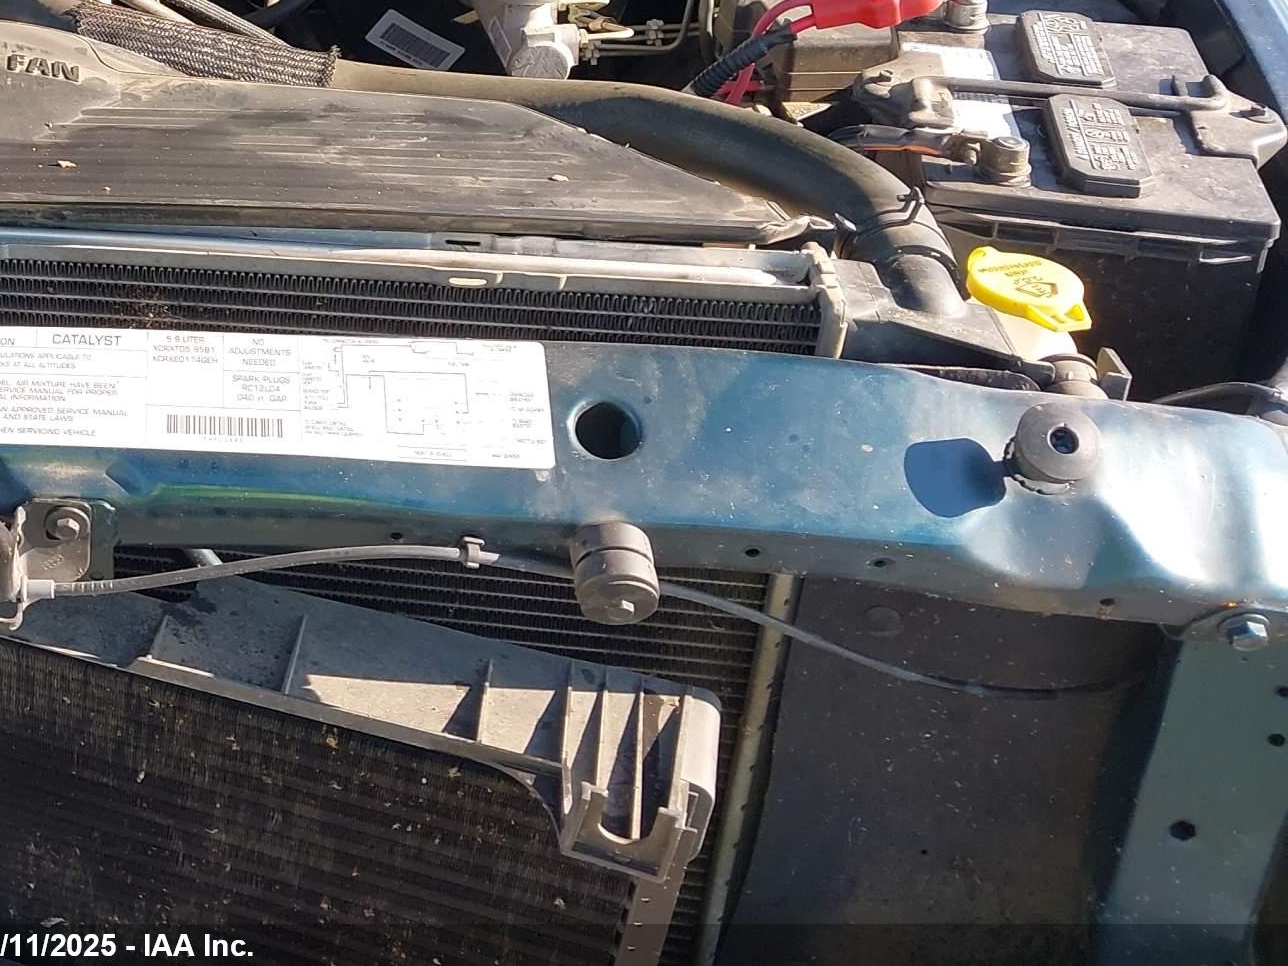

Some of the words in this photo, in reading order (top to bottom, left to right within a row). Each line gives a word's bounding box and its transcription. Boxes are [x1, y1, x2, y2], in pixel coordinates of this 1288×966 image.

[7, 54, 80, 83] FAN
[52, 334, 122, 346] CATALYST
[252, 338, 264, 346] NO
[229, 348, 291, 356] ADJUSTMENTS
[242, 358, 276, 366] NEEDED
[232, 374, 260, 382] SPARK
[262, 376, 290, 384] PLUGS
